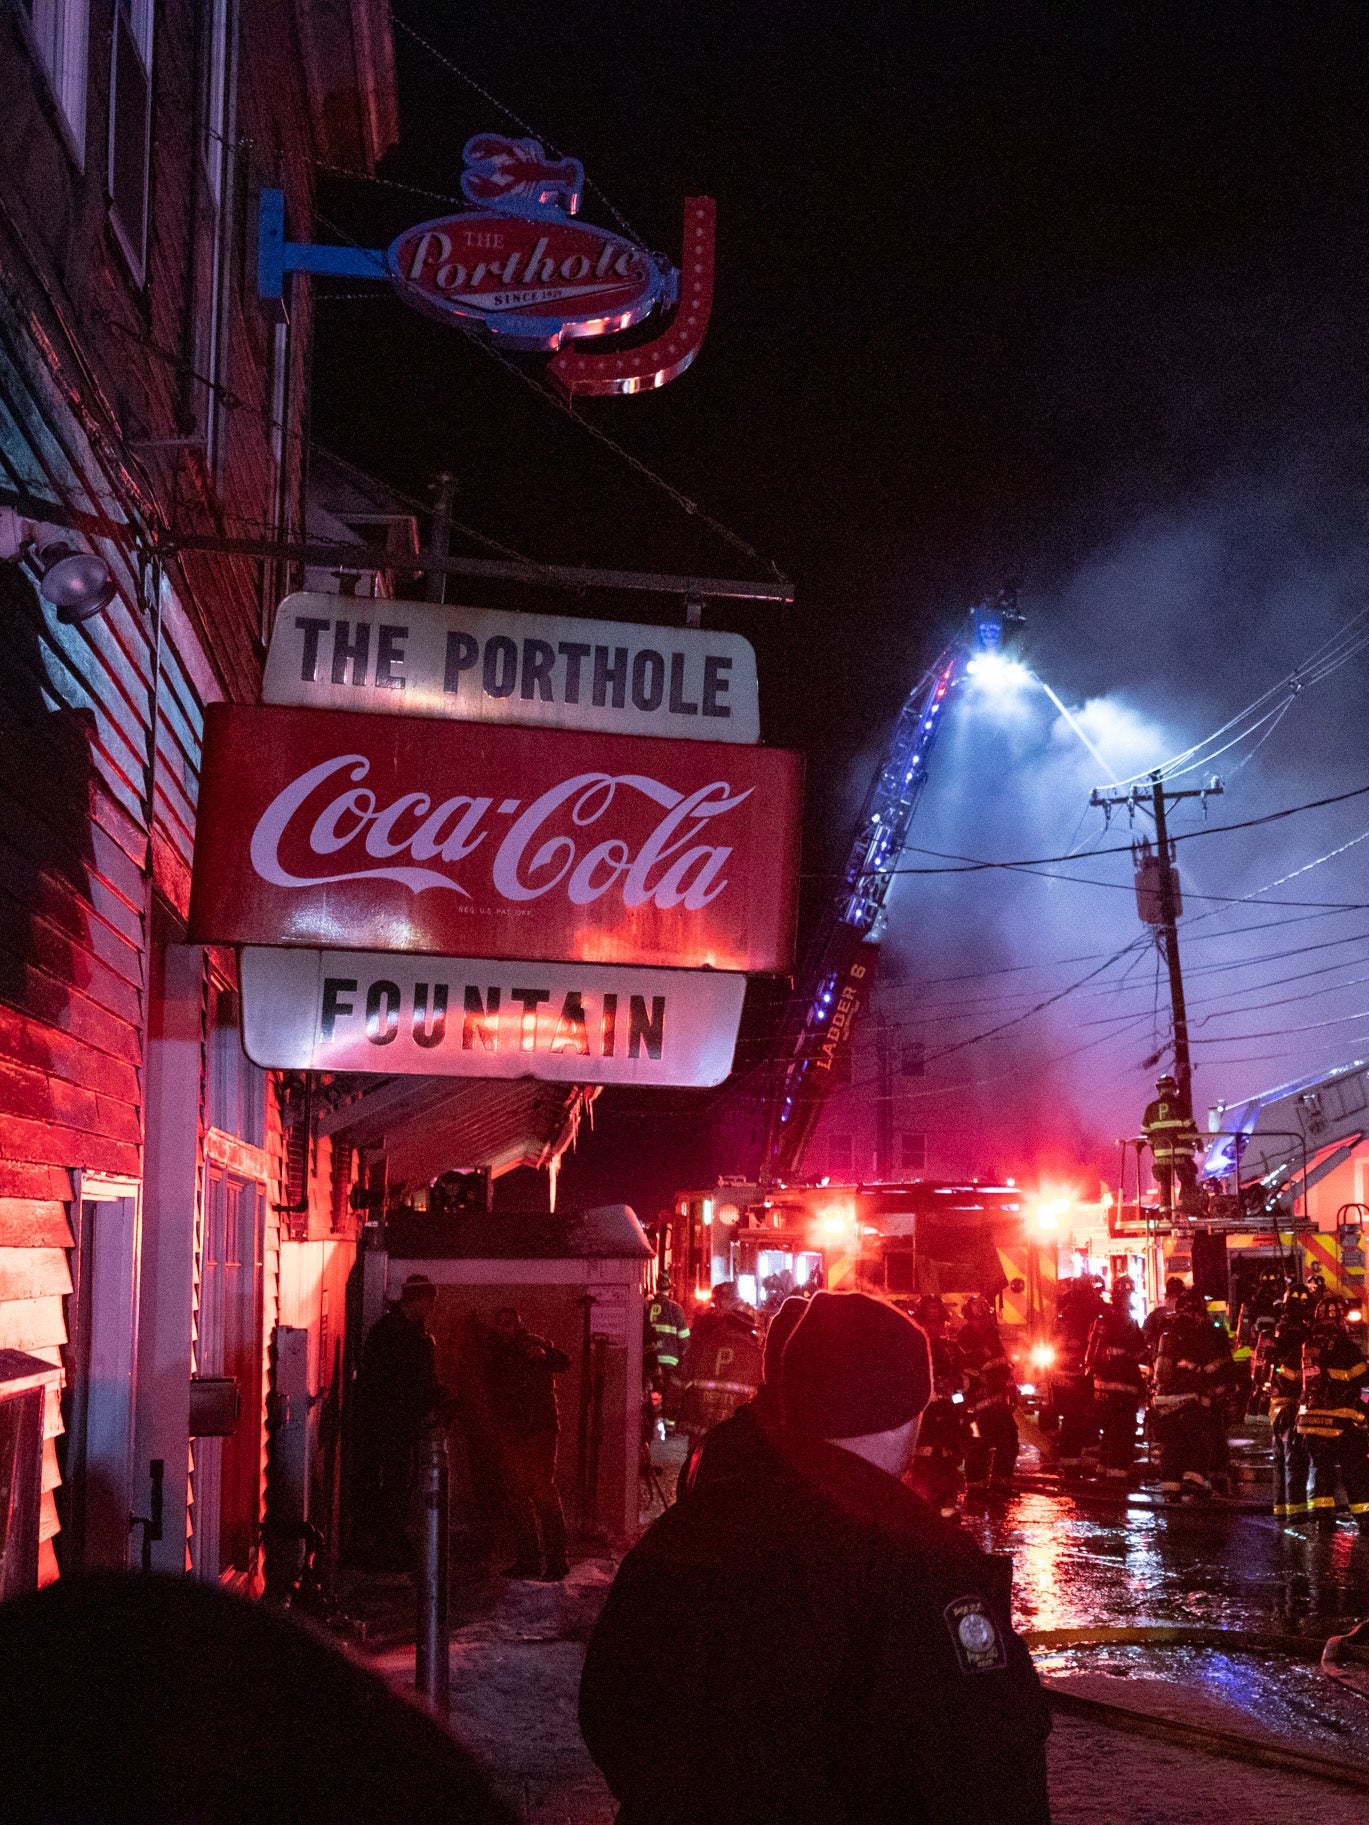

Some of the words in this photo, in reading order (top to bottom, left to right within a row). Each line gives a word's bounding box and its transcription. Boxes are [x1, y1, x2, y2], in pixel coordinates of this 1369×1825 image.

[404, 231, 647, 291] Porthole
[464, 230, 505, 250] THE
[494, 291, 538, 306] SINCE
[294, 616, 410, 690] THE
[442, 630, 733, 719] PORTHOLE
[250, 754, 757, 911] Coca-Cola
[320, 976, 667, 1061] FOUNTAIN
[817, 985, 857, 1070] LADDER
